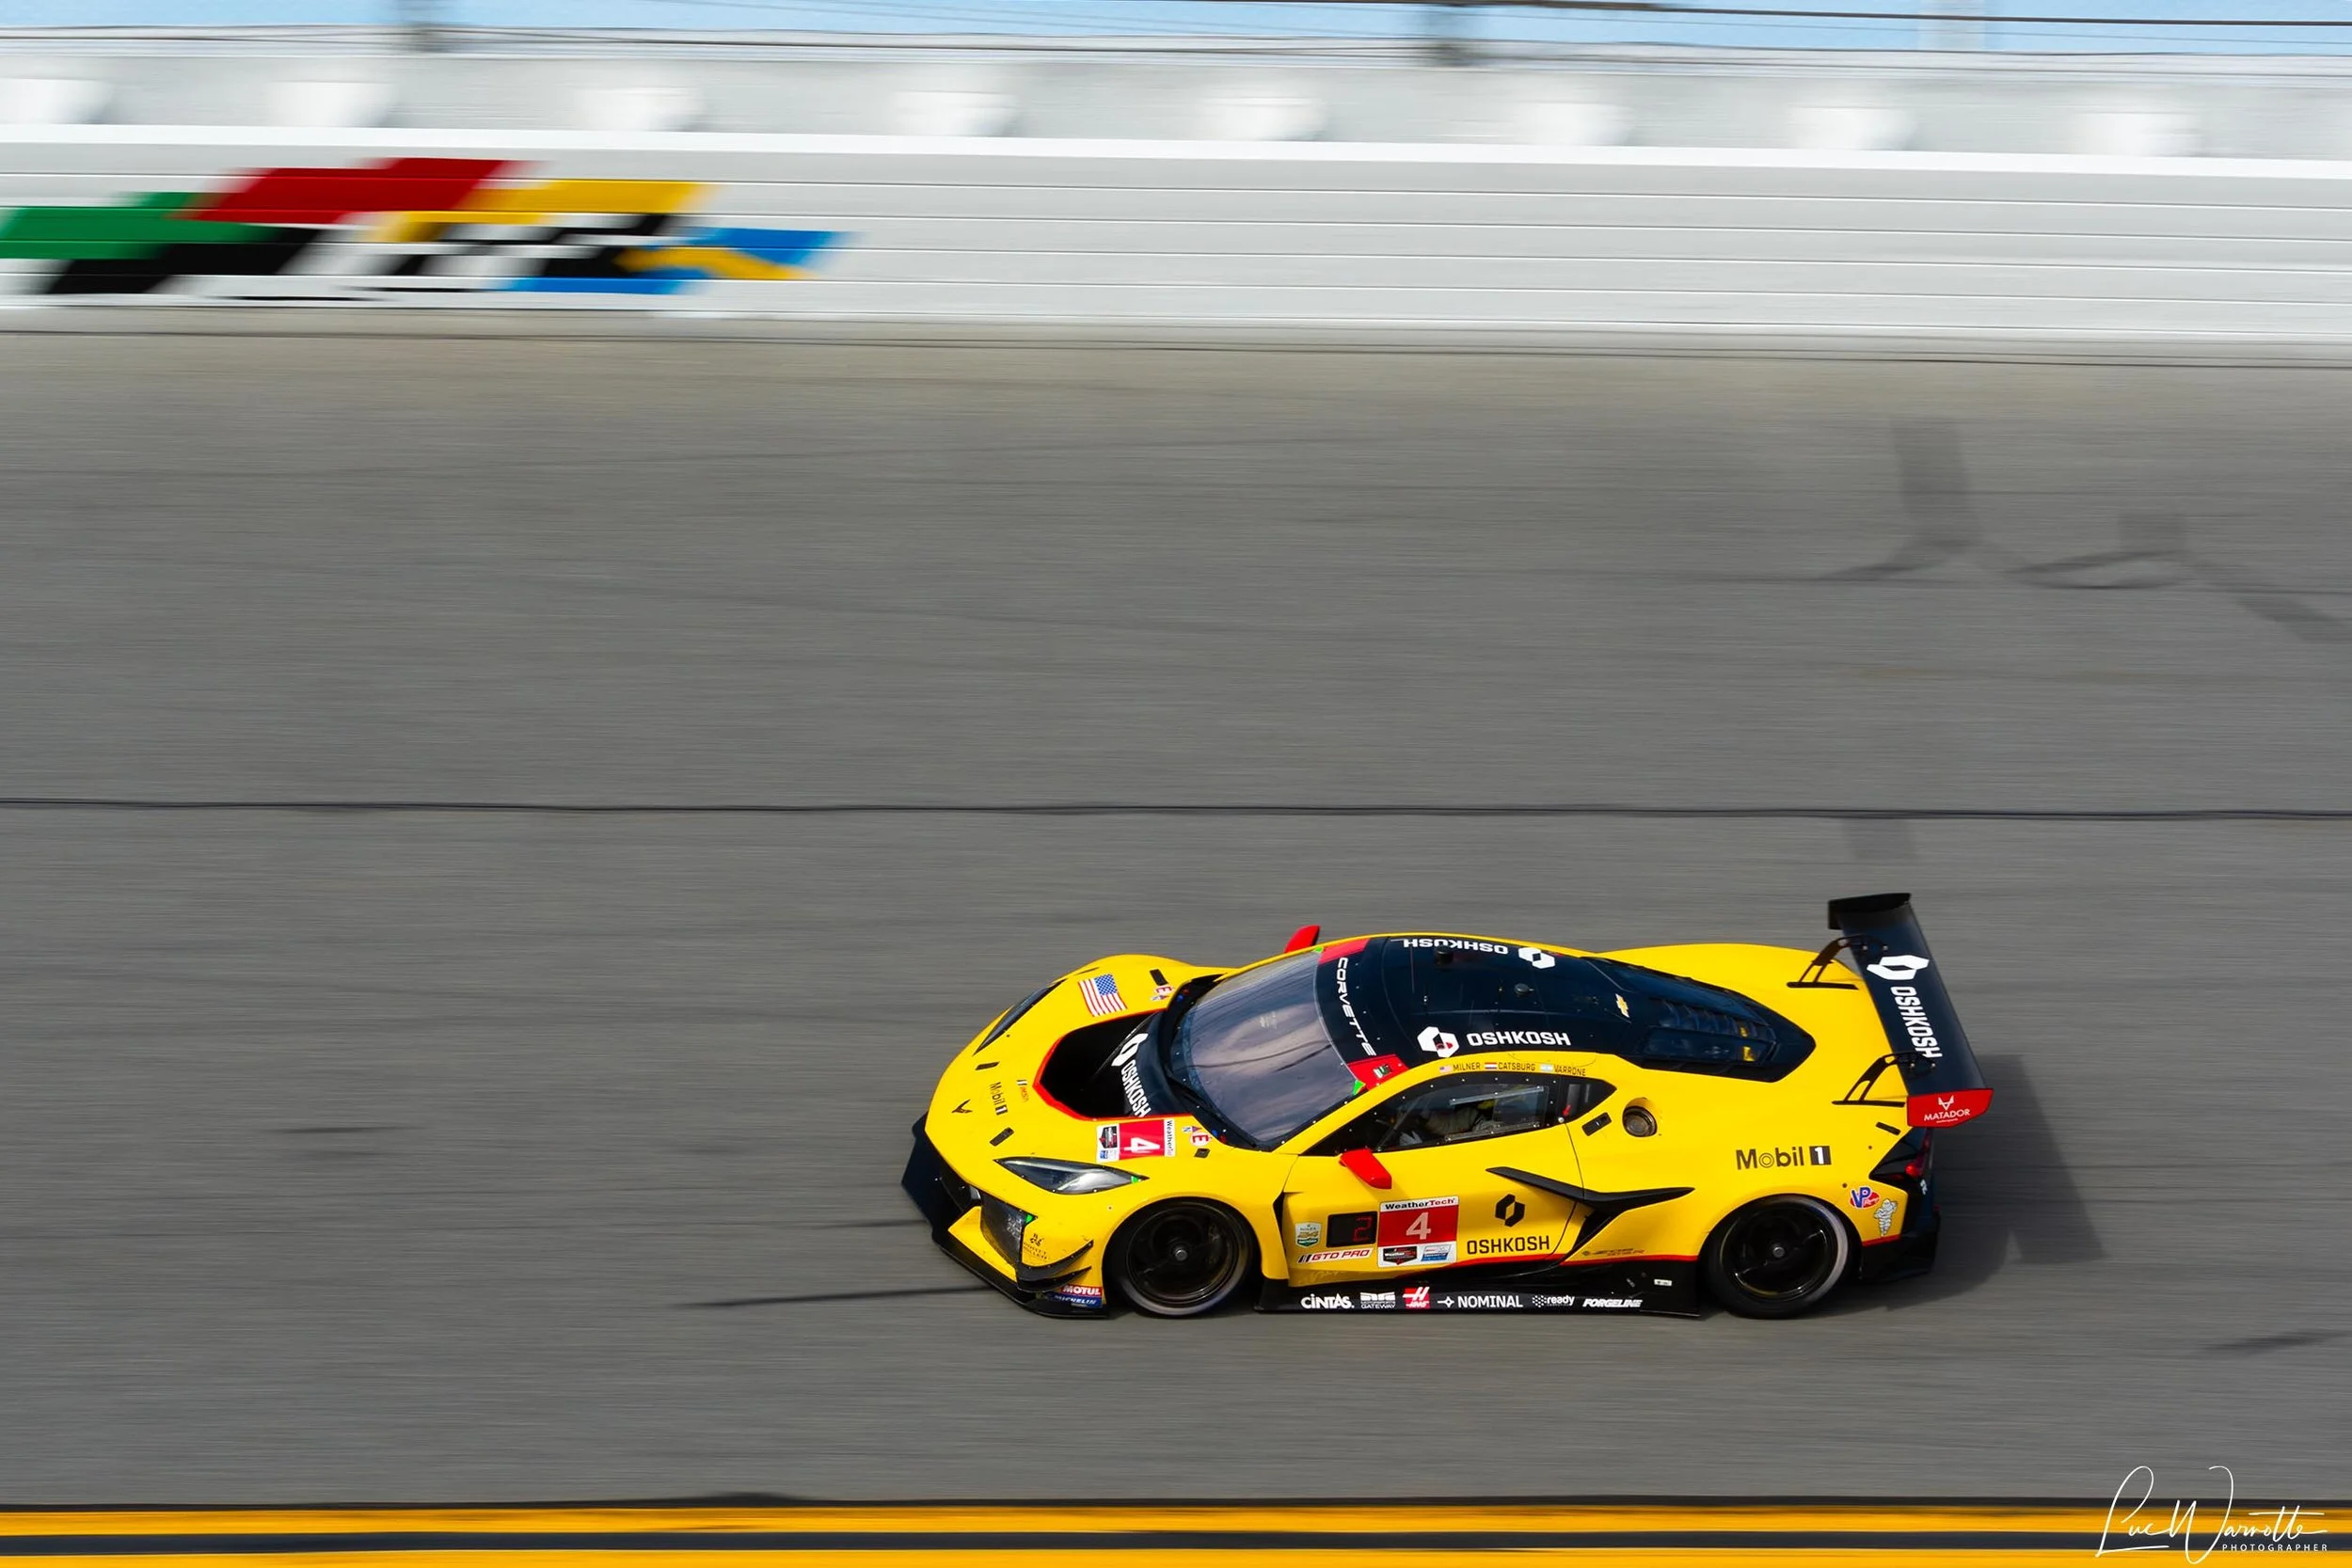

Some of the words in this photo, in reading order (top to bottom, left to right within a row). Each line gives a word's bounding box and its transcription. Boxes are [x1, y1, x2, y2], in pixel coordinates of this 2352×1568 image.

[1337, 958, 1376, 1055] CORVETTE
[1890, 986, 1943, 1058] OSHKOSH
[1466, 1031, 1571, 1046] OSHKOSH
[1453, 1062, 1481, 1071] MILNER
[1498, 1062, 1535, 1071] CATSBURG
[1554, 1064, 1586, 1076] VARRONE
[990, 1082, 1005, 1105] Mobil
[1121, 1059, 1152, 1117] OSHKOSH
[1924, 1108, 1970, 1121] MATADOR
[1124, 1137, 1160, 1153] 4
[1736, 1146, 1804, 1170] Mobil
[1385, 1197, 1455, 1211] WeatherTech
[1851, 1187, 1870, 1208] VP
[1353, 1216, 1373, 1242] 2
[1406, 1212, 1431, 1241] 4
[1467, 1235, 1550, 1255] OSHKOSH
[1311, 1252, 1340, 1261] GTD
[1341, 1249, 1370, 1259] PRO
[1062, 1285, 1101, 1295] MOTUL
[1457, 1295, 1523, 1308] NOMINAL
[1547, 1294, 1575, 1306] ready
[1582, 1298, 1643, 1307] FORGELINE
